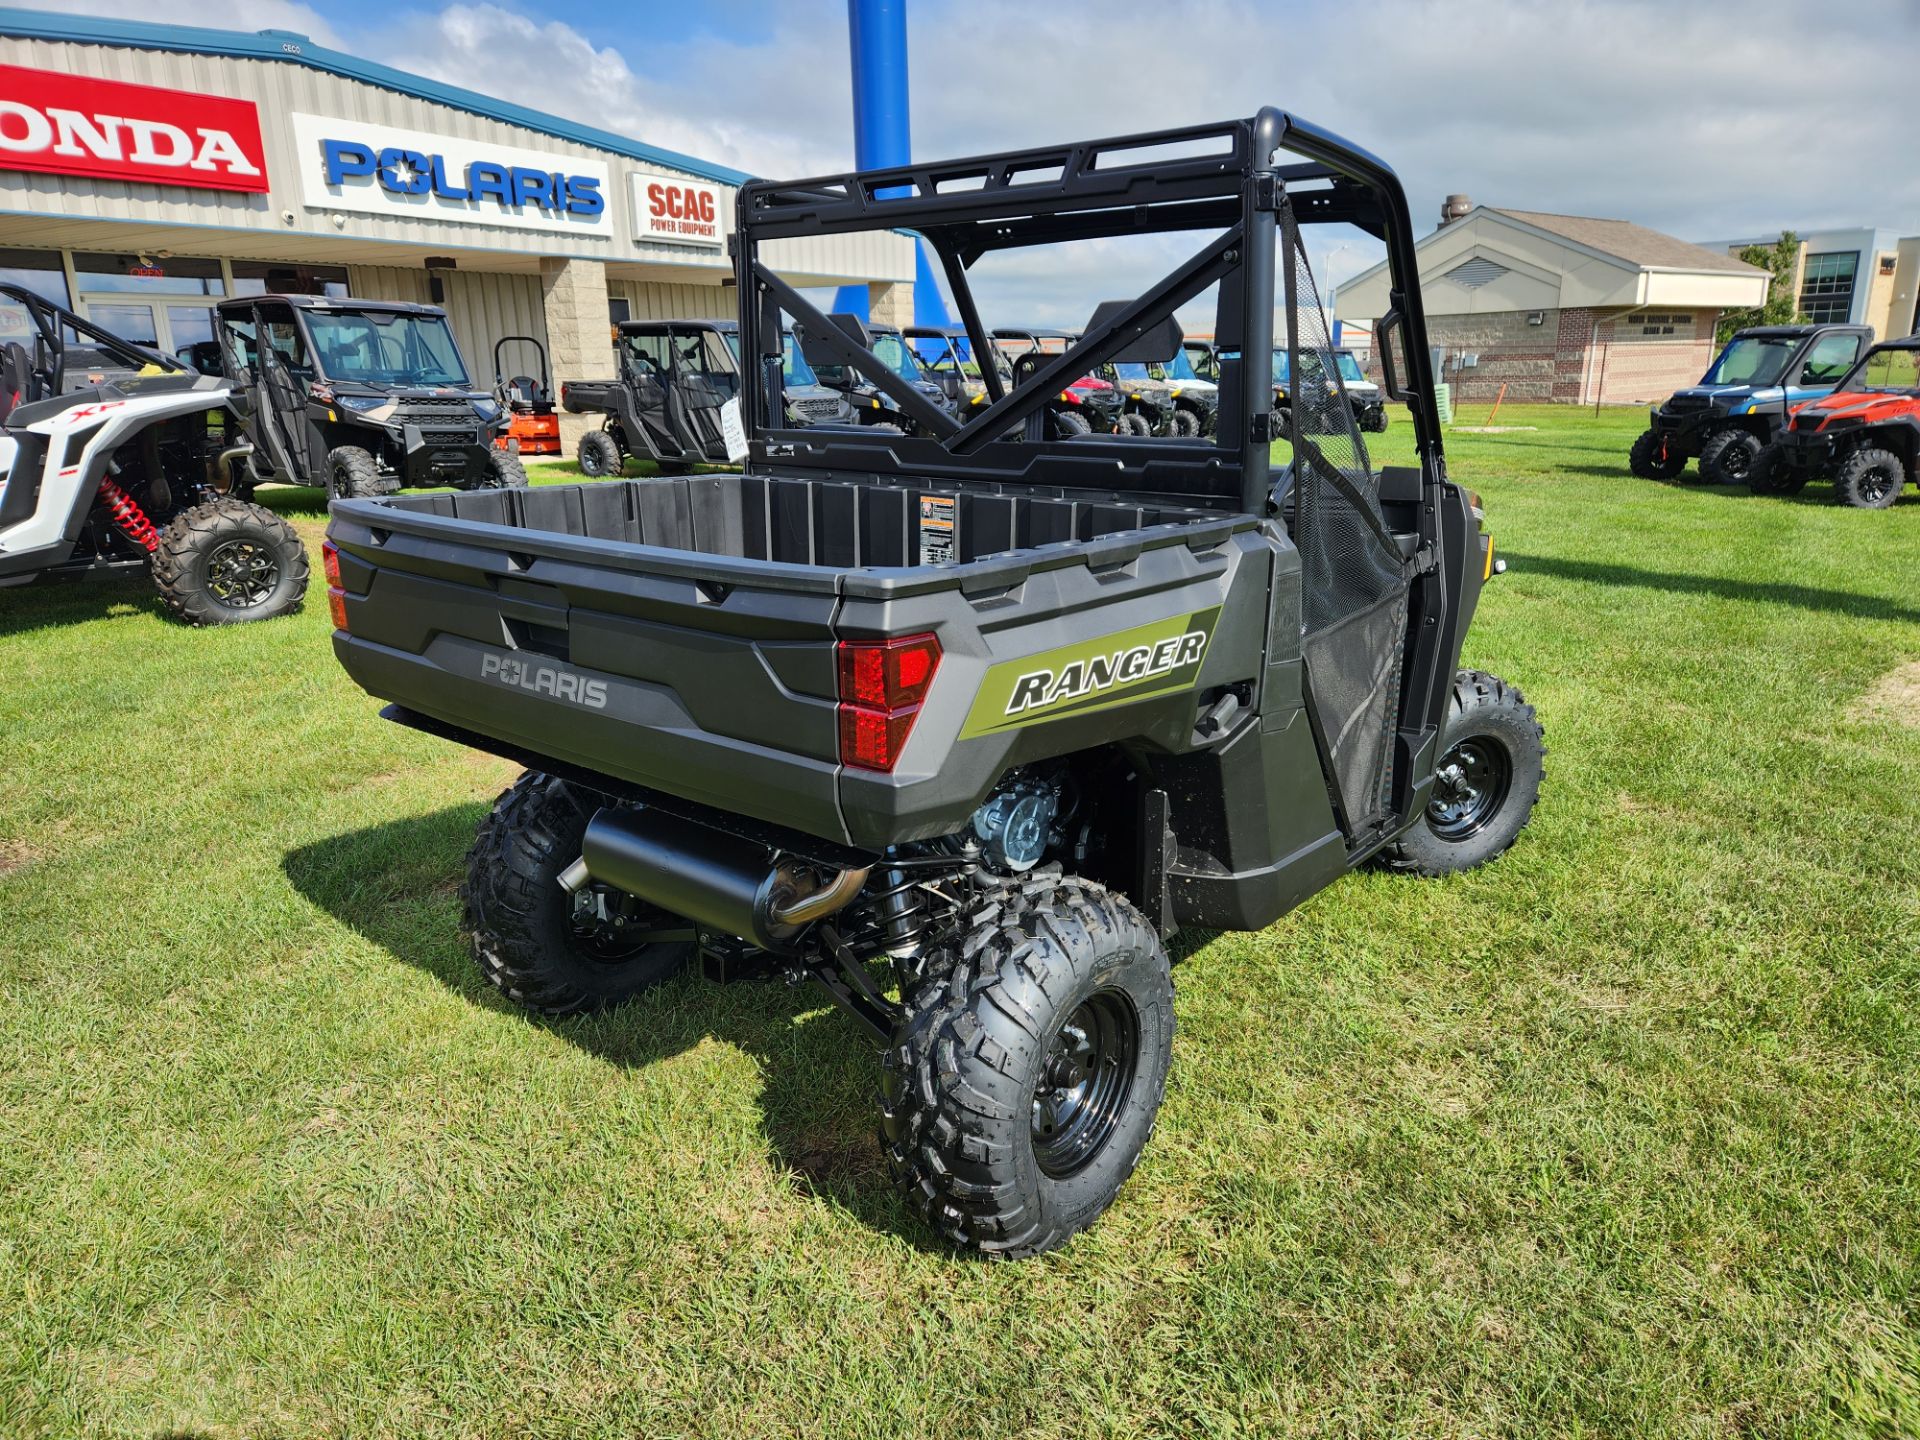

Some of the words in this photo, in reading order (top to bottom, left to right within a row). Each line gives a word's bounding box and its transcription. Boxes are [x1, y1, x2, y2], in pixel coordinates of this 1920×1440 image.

[321, 138, 605, 215] POLARIS
[647, 183, 715, 222] SCAG
[650, 218, 677, 232] POWER
[678, 221, 716, 237] EQUIPMENT
[129, 267, 164, 279] OPEN
[480, 652, 608, 709] POLARIS
[1004, 631, 1207, 715] RANGER
